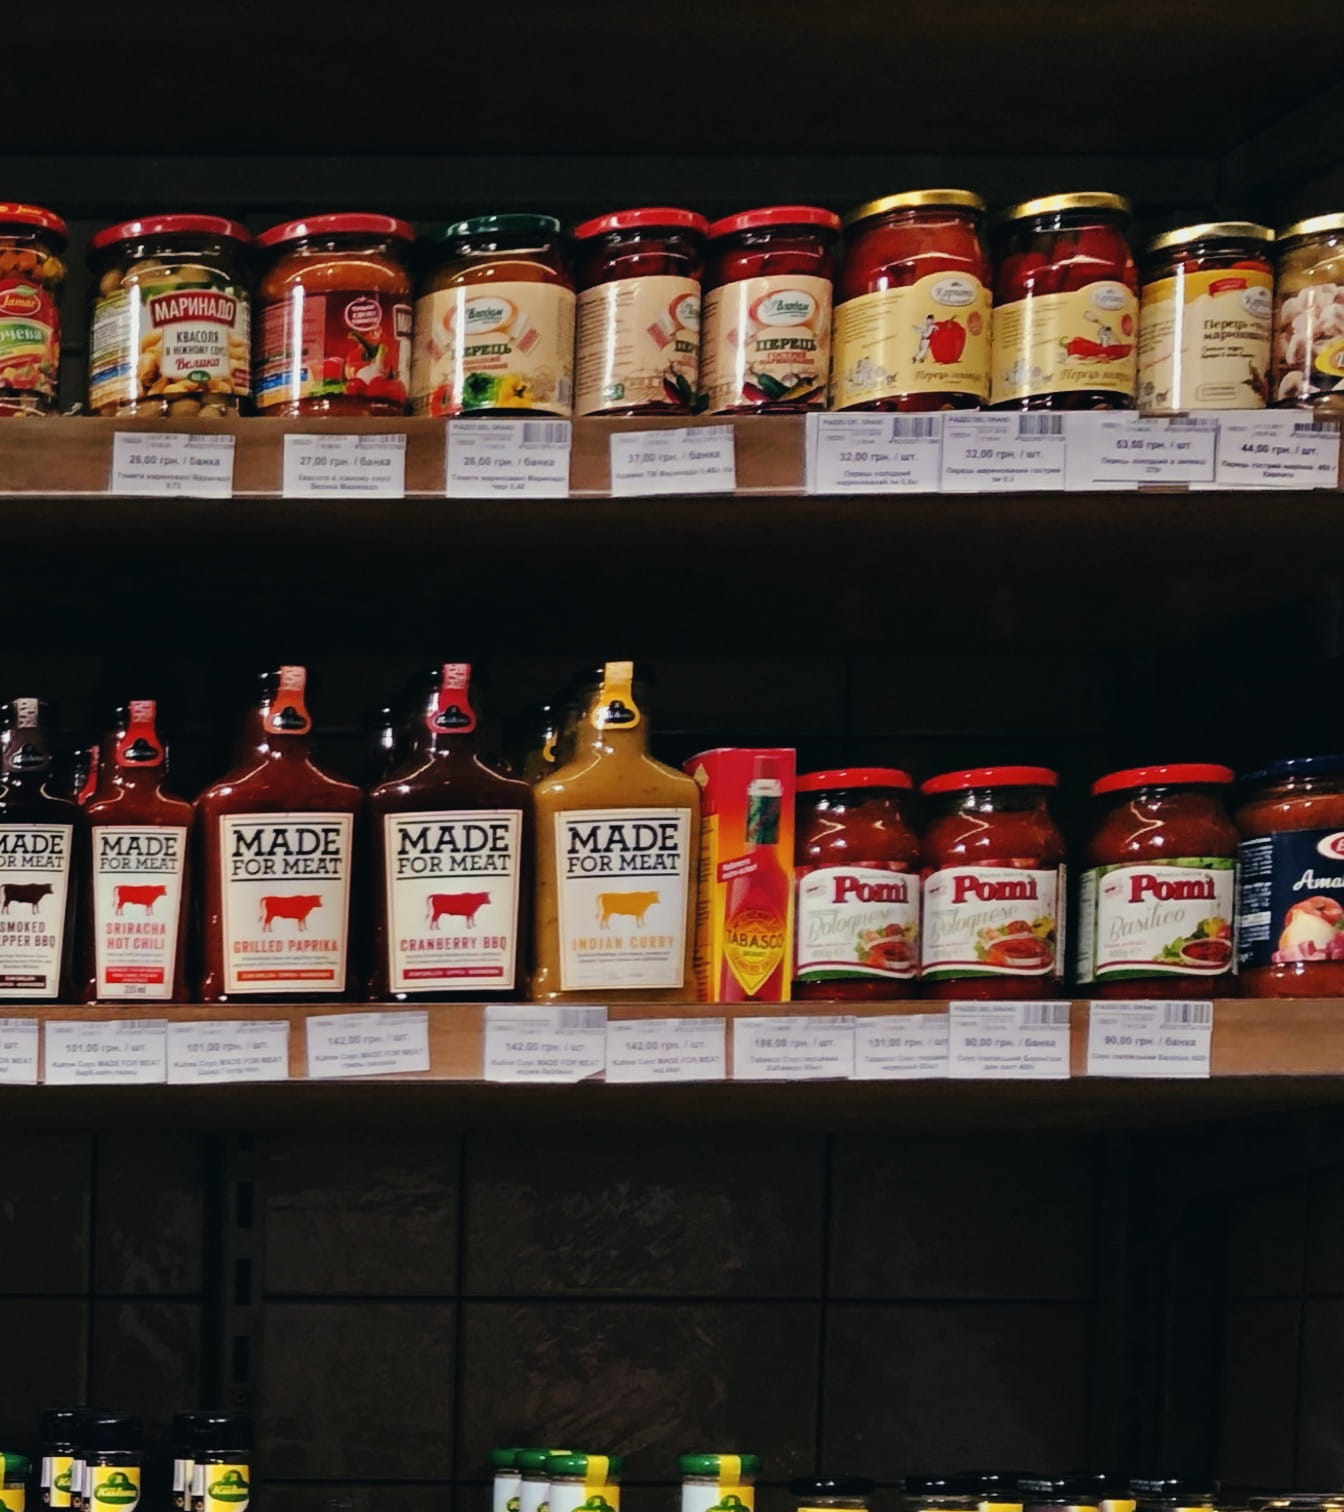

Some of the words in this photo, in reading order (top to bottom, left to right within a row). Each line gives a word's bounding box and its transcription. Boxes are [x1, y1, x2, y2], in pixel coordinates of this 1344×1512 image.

[0, 294, 39, 310] Jamar
[154, 298, 235, 322] МАРИНАДО
[101, 836, 177, 857] MADE
[233, 828, 340, 857] MADE
[397, 825, 510, 854] MADE
[568, 825, 679, 854] MADE
[20, 855, 65, 869] MEAT
[100, 857, 129, 870] FOR
[134, 857, 179, 871] MEAT
[232, 859, 275, 876] FOR
[282, 858, 343, 876] MEAT
[396, 856, 442, 876] FOR
[449, 855, 511, 875] MEAT
[567, 856, 612, 875] FOR
[619, 855, 680, 874] MEAT
[106, 923, 167, 935] SRIRACHA
[33, 935, 55, 948] BBQ
[234, 940, 280, 953] GRILLED
[288, 939, 338, 952] PAPRIKA
[401, 937, 477, 951] CRANBERRY
[483, 937, 507, 950] BBQ
[726, 930, 784, 948] TABASCO
